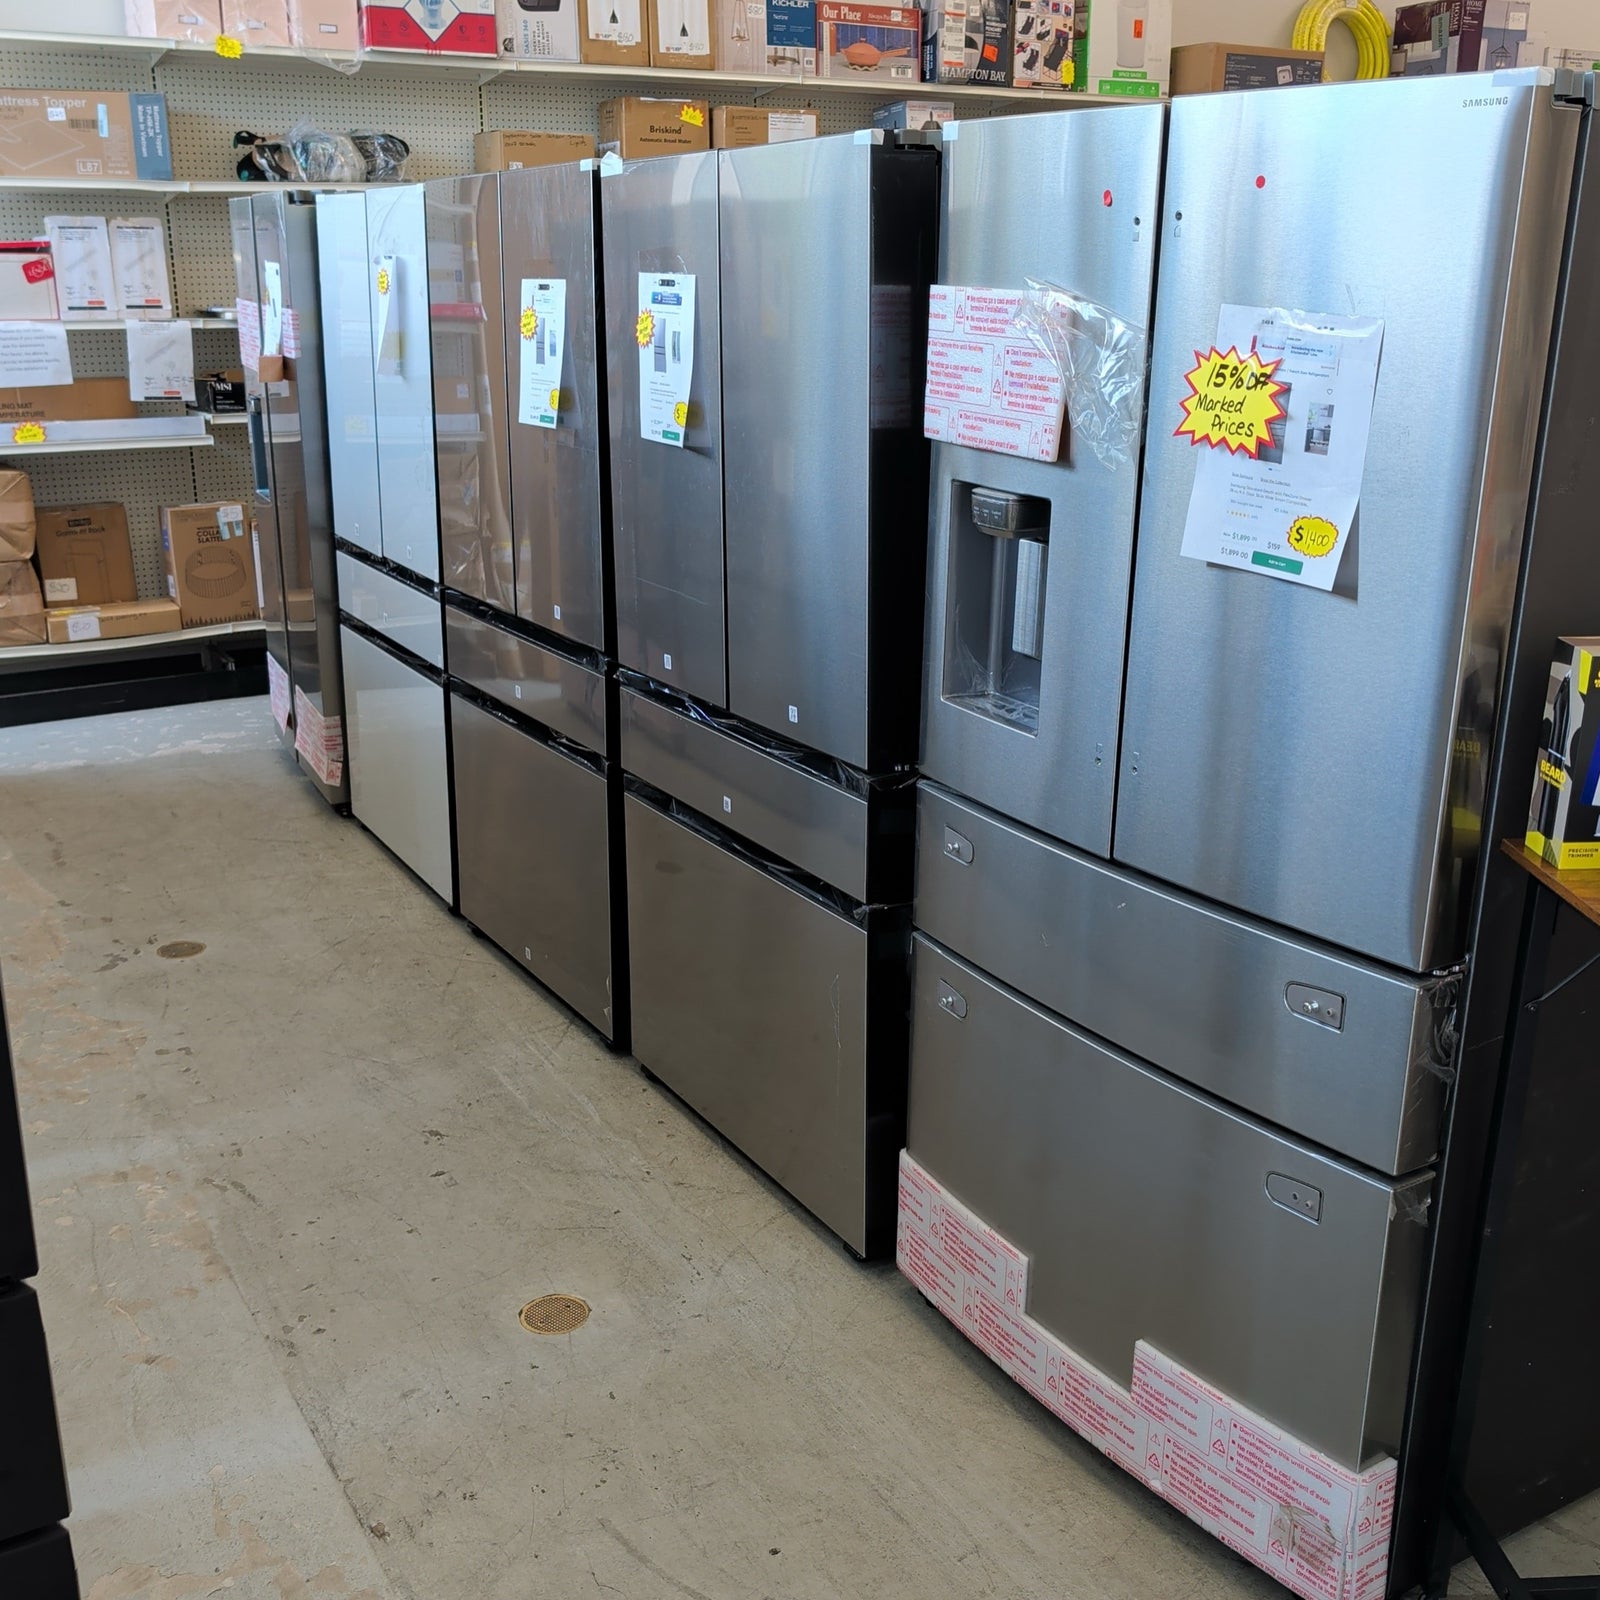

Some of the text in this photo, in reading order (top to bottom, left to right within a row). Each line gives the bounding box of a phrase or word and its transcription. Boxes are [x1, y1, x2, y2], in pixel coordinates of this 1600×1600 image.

[823, 4, 861, 21] Our Place
[941, 66, 1006, 82] HAMPTON BAY
[43, 96, 87, 109] Topper
[1462, 96, 1509, 109] SAMSUNG
[649, 125, 682, 135] Briskind
[1207, 363, 1248, 391] 15%
[215, 382, 232, 391] MSI
[1195, 393, 1247, 414] Marked
[1211, 414, 1254, 438] Prices
[196, 529, 221, 538] COLLA
[1267, 542, 1280, 550] $159
[1540, 759, 1566, 783] BEARD
[1239, 1427, 1332, 1488] Don't remove this until finishing
[1207, 1466, 1217, 1476] this
[1219, 1474, 1231, 1484] until
[1232, 1481, 1256, 1502] finishing
[1279, 1471, 1291, 1481] ceci
[1292, 1480, 1309, 1493] avant
[1236, 1460, 1244, 1468] No
[1245, 1466, 1266, 1482] remover
[1267, 1481, 1278, 1490] esta
[1303, 1502, 1318, 1516] hasta
[1319, 1513, 1330, 1524] que
[1244, 1526, 1255, 1536] que
[1265, 1566, 1276, 1577] this
[1277, 1574, 1290, 1586] until
